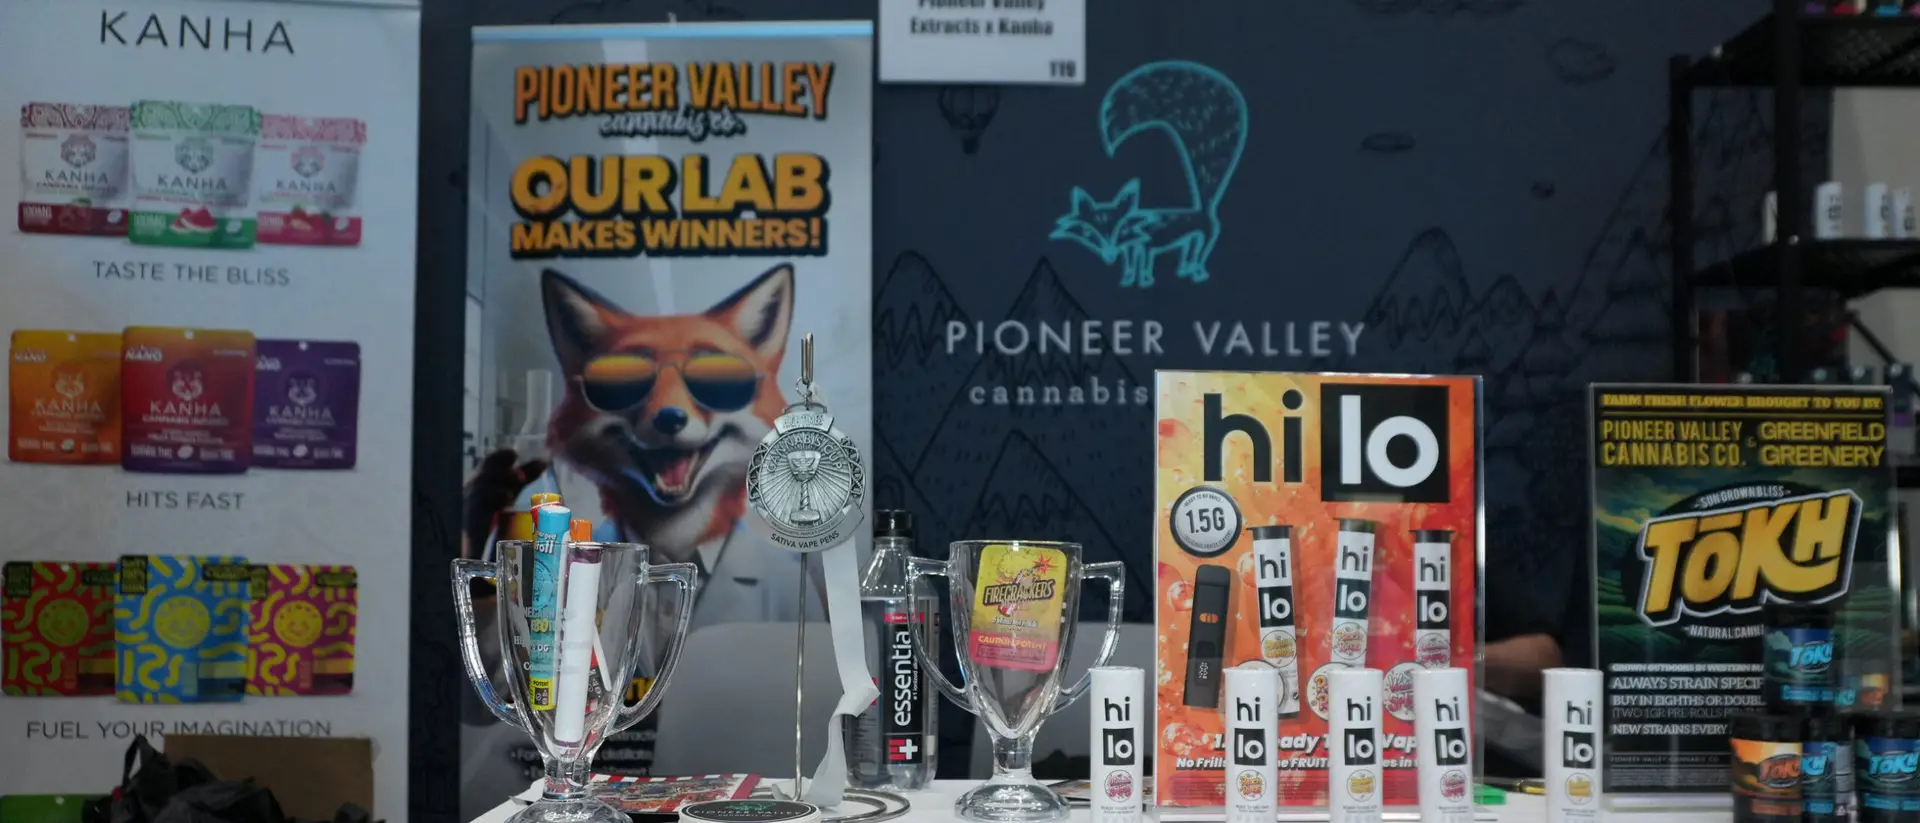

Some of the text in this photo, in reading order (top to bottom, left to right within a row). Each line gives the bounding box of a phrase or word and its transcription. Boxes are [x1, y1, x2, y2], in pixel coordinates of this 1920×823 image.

[100, 10, 295, 54] KANHA
[911, 17, 980, 34] Extracts
[999, 17, 1054, 35] Kanha
[514, 61, 834, 124] PIONEER VALLEY
[44, 169, 109, 185] KANHA
[157, 174, 228, 191] KANHA
[275, 178, 337, 194] KANHA
[511, 153, 826, 216] OUR LAB
[512, 217, 824, 251] MAKES WINNERS!
[92, 260, 291, 287] TASTE THE BLISS
[945, 320, 1367, 355] PIONEER VALLEY
[256, 357, 281, 371] ANO
[969, 377, 1150, 405] cannabis
[1603, 394, 1642, 407] FARM
[1645, 394, 1688, 408] FRESH
[1690, 395, 1744, 409] FLOWER
[1747, 396, 1811, 409] BROUGHT
[1813, 397, 1832, 409] TO
[1835, 397, 1862, 409] YOU
[35, 398, 103, 414] KANHA
[150, 401, 222, 417] KANHA
[269, 405, 334, 421] KANHA
[1204, 389, 1439, 487] hi lo
[1603, 420, 1743, 442] PIONEER VALLEY
[1760, 422, 1886, 442] GREENFIELD
[1604, 442, 1747, 467] CANNABIS CO.
[1760, 446, 1884, 467] GREENERY
[126, 491, 244, 510] HITS FAST
[1699, 484, 1785, 509] SUN GROWN BLISS
[1186, 507, 1226, 534] 1.5G
[771, 530, 840, 549] SATIVA VAPE PENS
[1260, 552, 1289, 580] hi
[1341, 545, 1371, 572] hi
[1419, 555, 1446, 582] hi
[984, 580, 1055, 605] FIRECRACKERS
[1340, 583, 1368, 612] lo
[1262, 592, 1292, 621] lo
[1420, 594, 1449, 623] lo
[1689, 624, 1733, 640] NATURAL
[893, 630, 912, 727] essentia
[1612, 677, 1765, 690] ALWAYS STRAIN SPECIF
[1104, 696, 1131, 722] hi
[1235, 696, 1261, 722] hi
[1347, 696, 1371, 721] hi
[1435, 696, 1460, 722] hi
[1567, 700, 1593, 725] hi
[1612, 695, 1767, 706] BUY IN EIGHTHS OR DOUBL
[26, 719, 333, 739] FUEL YOUR IMAGINATION
[1612, 724, 1729, 735] NEW STRAINS EVERY
[1107, 734, 1134, 759] lo
[1238, 733, 1265, 760] lo
[1347, 733, 1375, 759] lo
[1382, 733, 1417, 754] Vap
[1439, 733, 1467, 760] lo
[1566, 736, 1595, 763] lo
[1176, 757, 1195, 768] No
[1290, 757, 1330, 768] FRUIT
[1399, 756, 1412, 768] in
